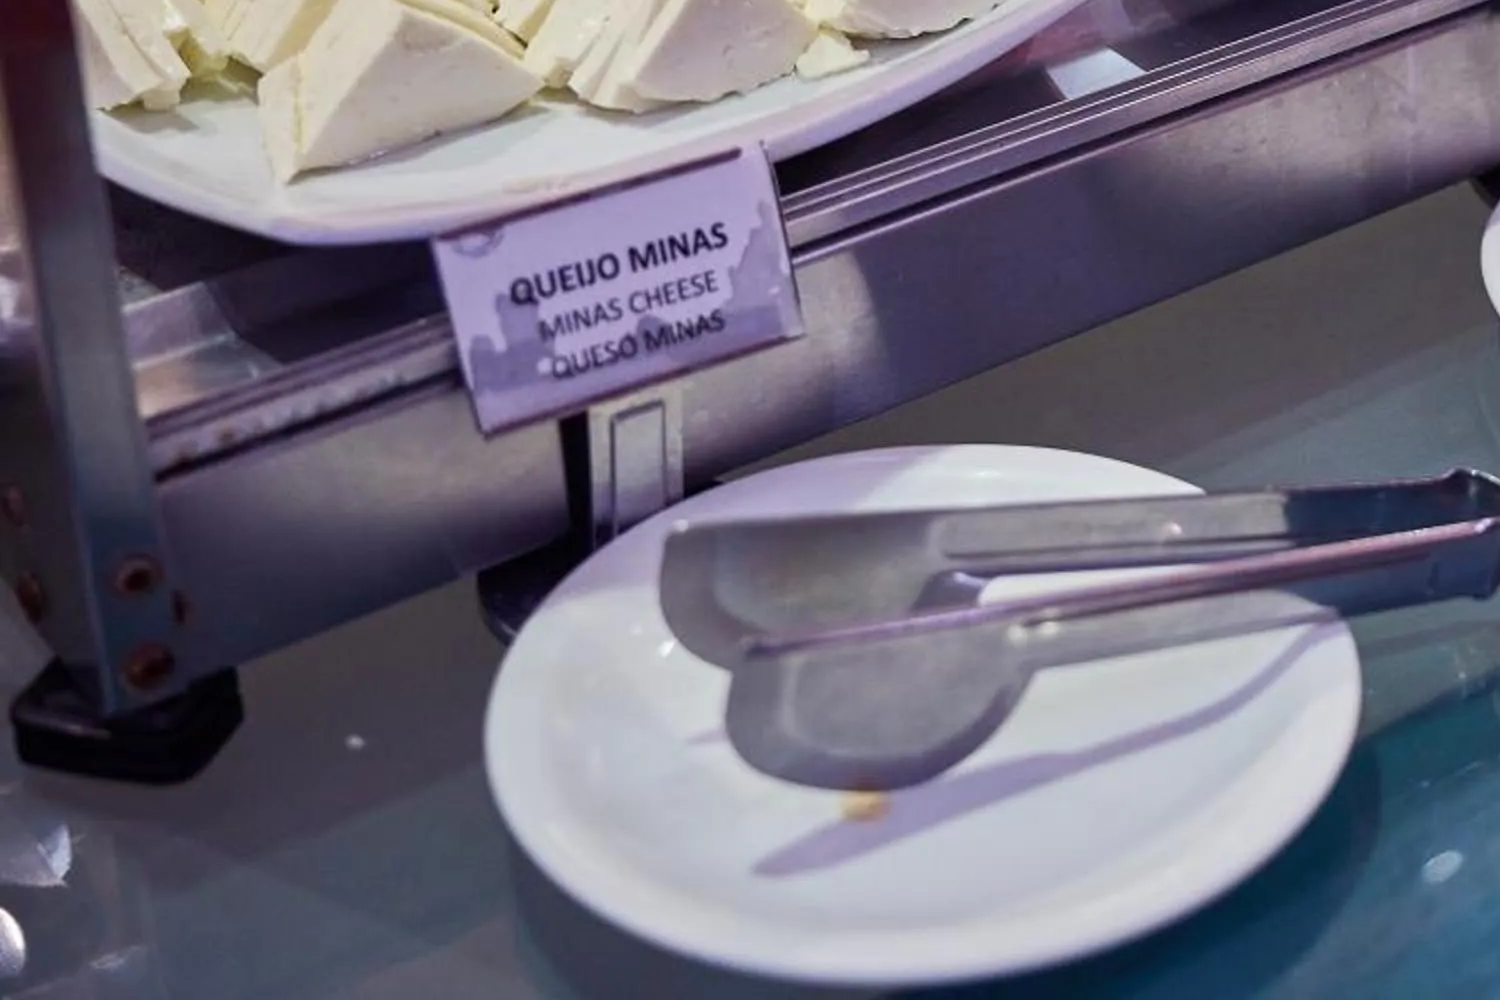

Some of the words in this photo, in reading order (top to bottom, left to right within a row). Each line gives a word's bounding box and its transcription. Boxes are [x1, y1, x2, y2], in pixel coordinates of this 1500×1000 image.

[510, 253, 620, 306] QUEIJO
[628, 222, 729, 273] MINAS
[538, 297, 623, 342] MINAS
[629, 270, 720, 315] CHEESE
[551, 334, 638, 380] QUESO
[642, 308, 726, 353] MINAS
